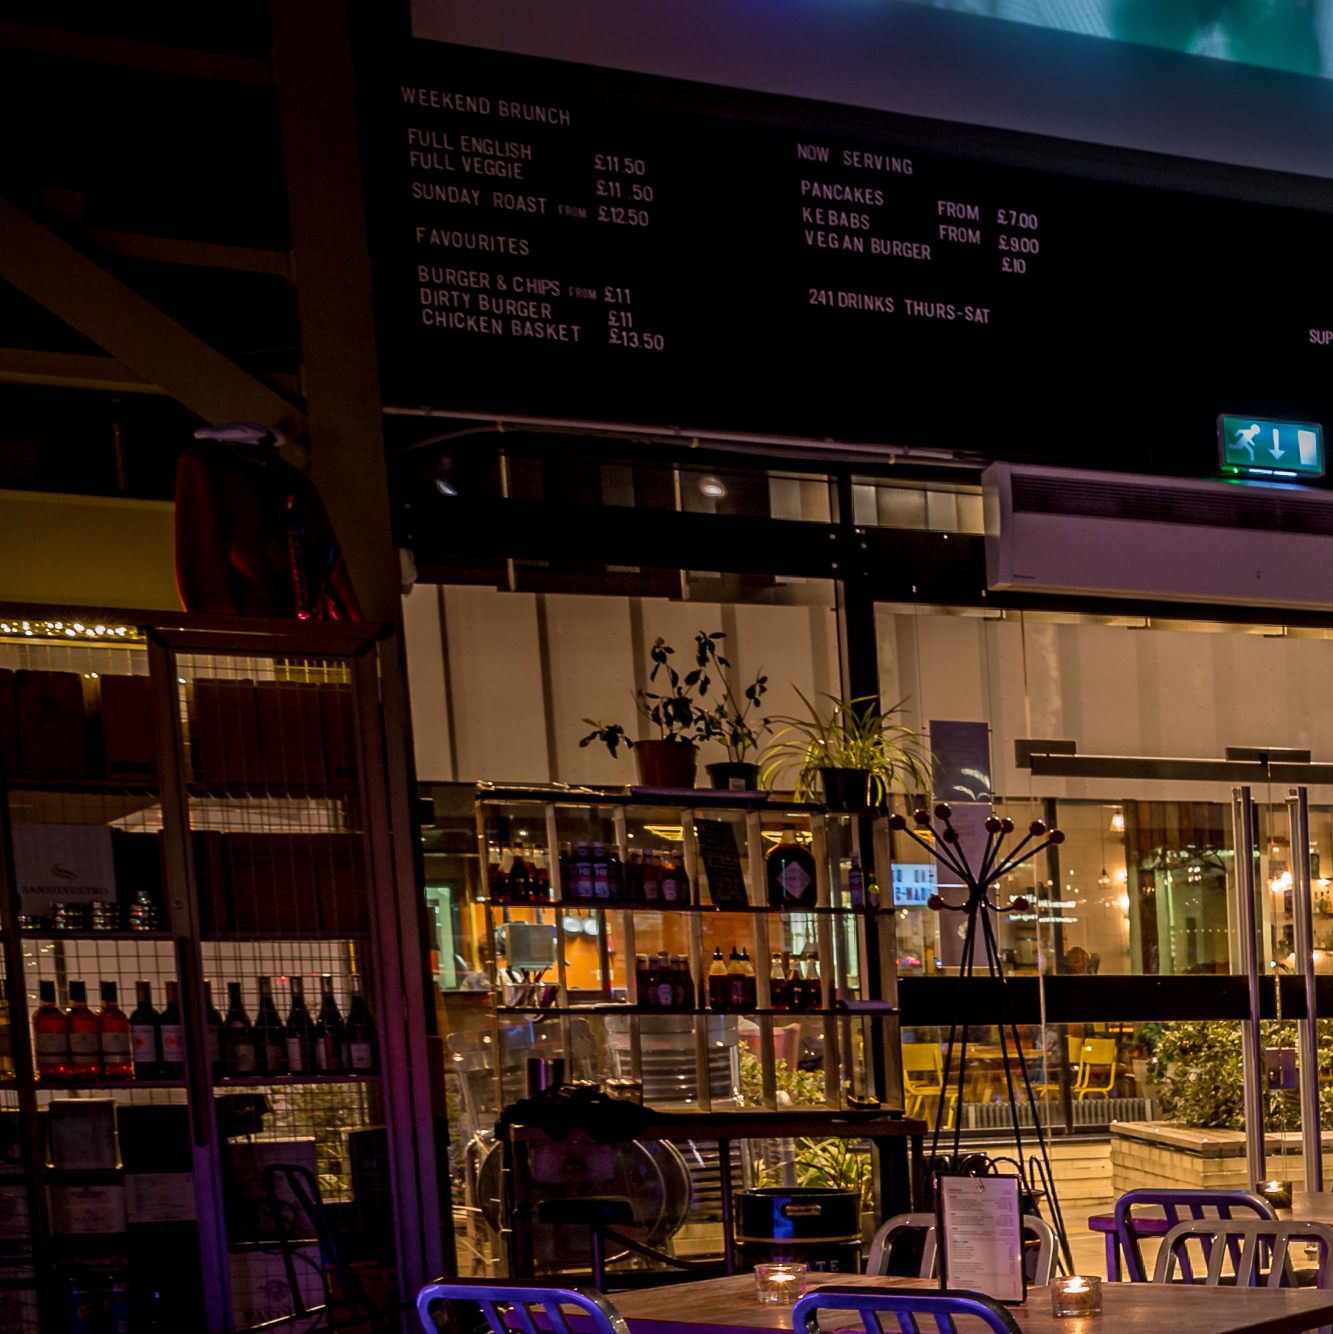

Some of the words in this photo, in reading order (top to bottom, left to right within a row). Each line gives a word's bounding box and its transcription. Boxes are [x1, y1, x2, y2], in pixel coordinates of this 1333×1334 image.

[401, 86, 491, 115] WEEKEND
[499, 99, 571, 126] BRUNCH
[408, 127, 455, 150] FULL
[460, 135, 532, 161] ENGLISH
[797, 142, 829, 163] NOW
[842, 149, 913, 175] SERVING
[409, 150, 456, 171] FULL
[461, 155, 524, 180] VEGGIE
[412, 181, 480, 206] SUNDAY
[492, 191, 548, 214] ROAST
[558, 203, 587, 218] FROM
[800, 179, 884, 206] PANCAKES
[937, 199, 980, 221] FROM
[802, 206, 870, 230] KEBABS
[939, 224, 981, 246] FROM
[804, 229, 864, 253] VEGAN
[870, 237, 931, 260] BURGER
[1001, 256, 1027, 275] £10
[417, 264, 490, 289] BURGER
[496, 273, 508, 291] &
[512, 275, 561, 297] CHIPS
[568, 285, 598, 301] FROM
[603, 285, 631, 305] £11
[419, 287, 471, 310] DIRTY
[478, 293, 552, 320] BURGER
[607, 309, 633, 328] £11
[808, 288, 834, 307] 241
[837, 291, 895, 313] DRINKS
[904, 298, 990, 325] THURS-SAT
[422, 308, 503, 335] CHICKEN
[511, 318, 581, 343] BASKET
[608, 328, 664, 351] £13.50
